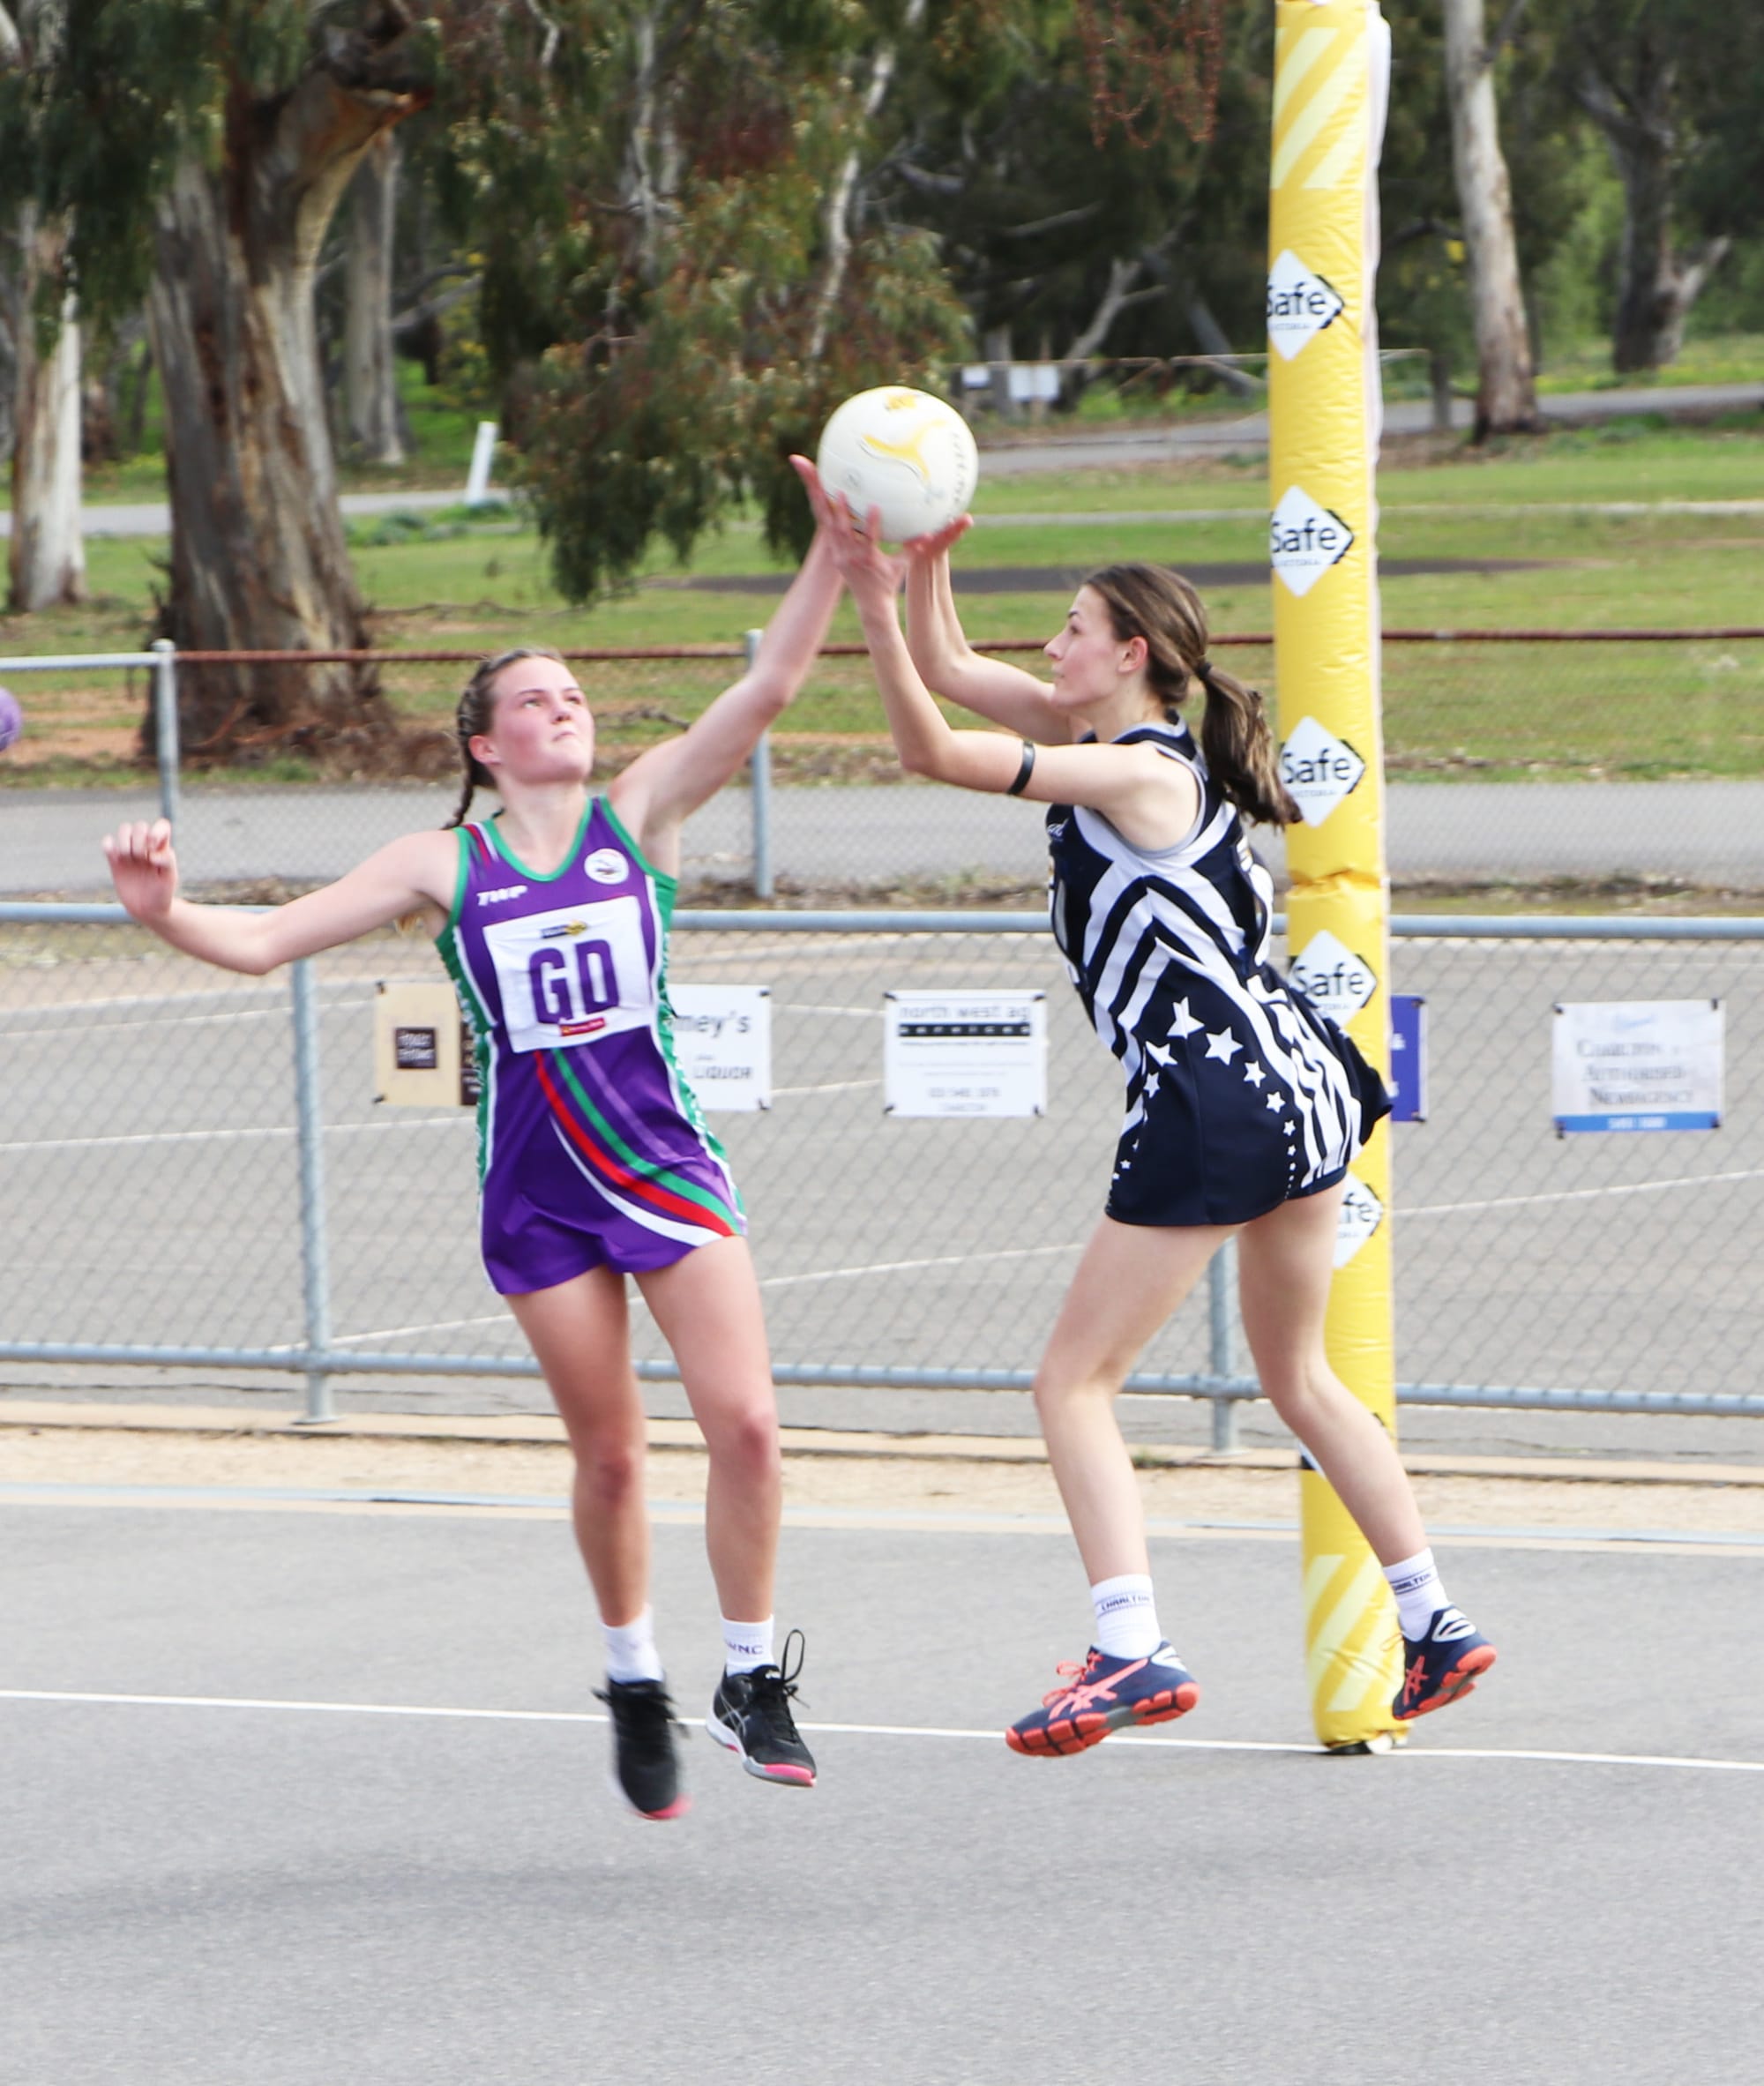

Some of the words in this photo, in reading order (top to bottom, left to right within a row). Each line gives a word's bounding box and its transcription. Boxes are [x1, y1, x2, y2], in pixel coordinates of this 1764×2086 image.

[1282, 748, 1350, 784] Safe
[529, 939, 620, 1025] GD
[1295, 961, 1364, 997] Safe
